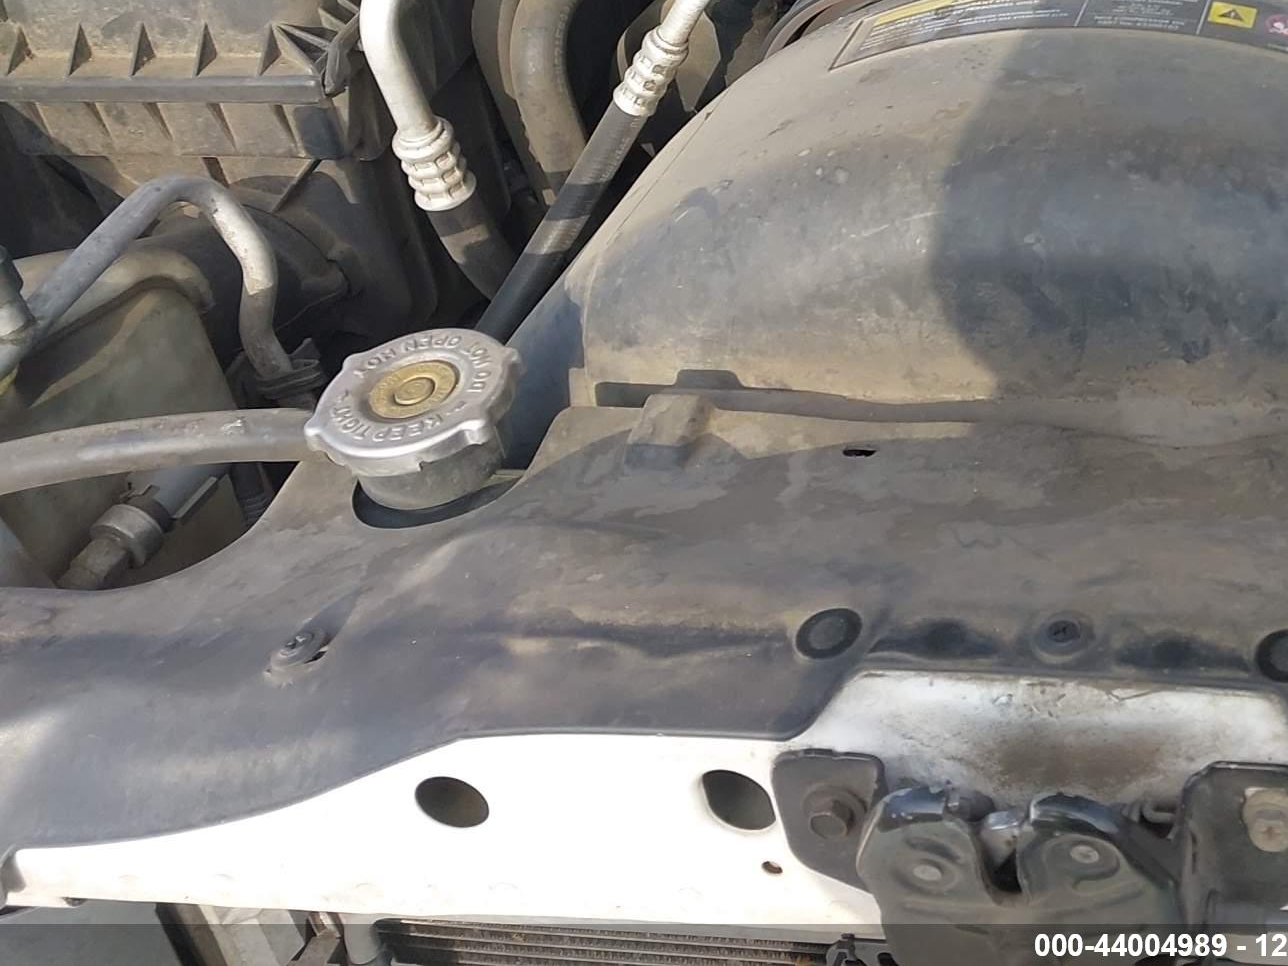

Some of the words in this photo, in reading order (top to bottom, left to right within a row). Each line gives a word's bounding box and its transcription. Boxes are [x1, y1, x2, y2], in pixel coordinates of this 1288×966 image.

[402, 335, 463, 352] OPEN
[330, 406, 371, 441] TIGHT
[372, 414, 444, 443] KEEP
